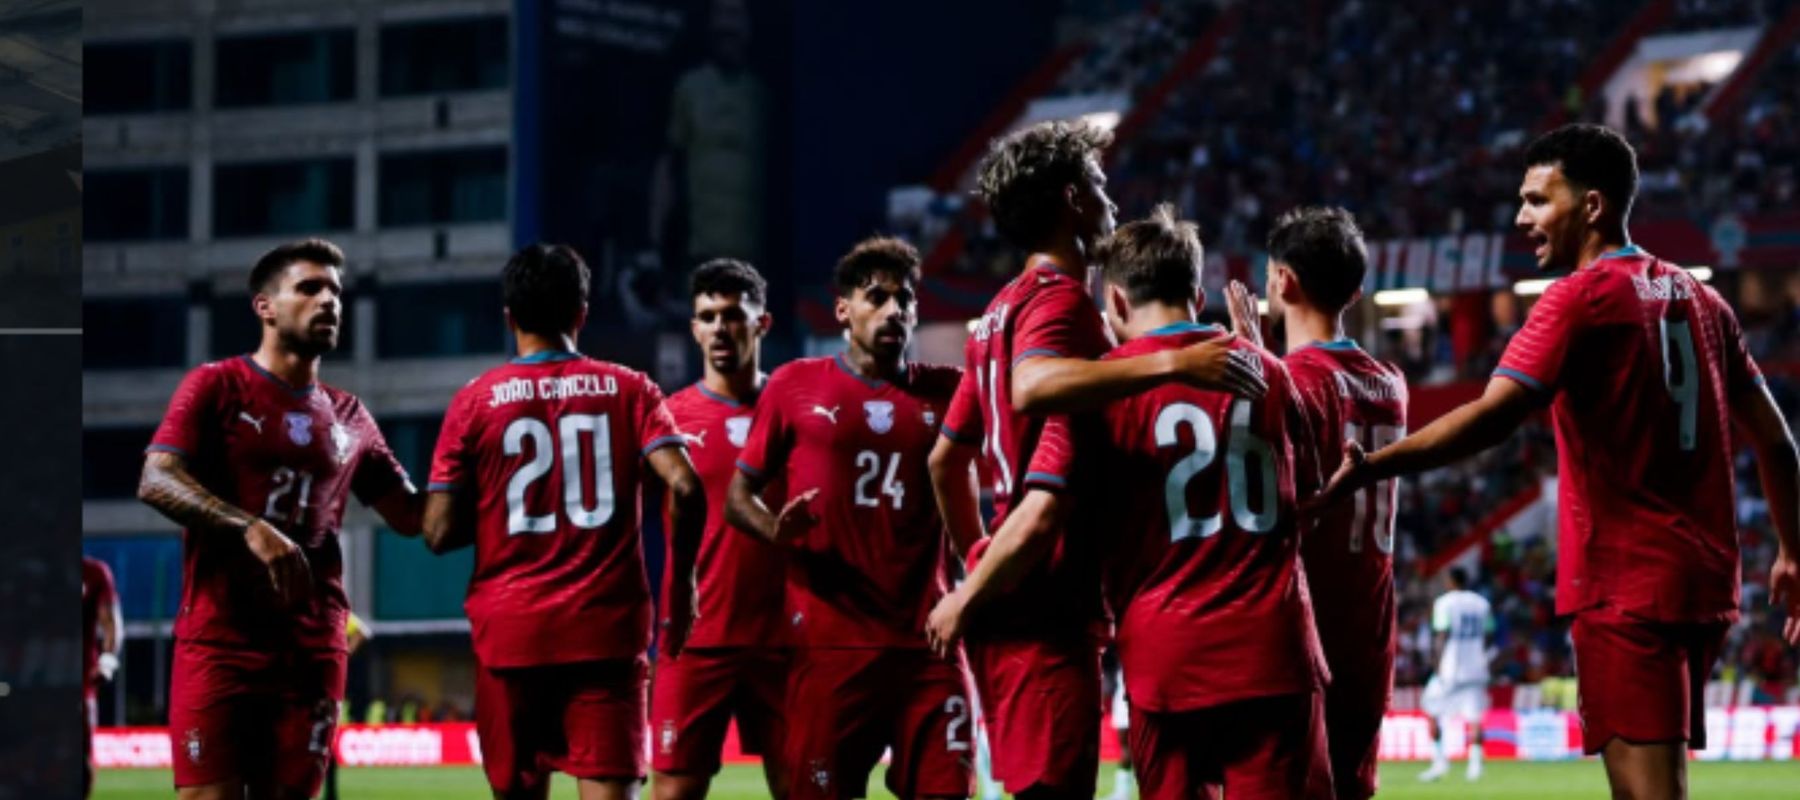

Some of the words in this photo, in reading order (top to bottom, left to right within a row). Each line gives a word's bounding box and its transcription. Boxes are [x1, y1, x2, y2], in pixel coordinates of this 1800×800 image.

[538, 374, 618, 400] CANCELO
[1659, 316, 1699, 451] 9
[264, 466, 313, 524] 21
[503, 412, 615, 536] 20
[854, 449, 905, 510] 24
[1154, 400, 1279, 544] 26
